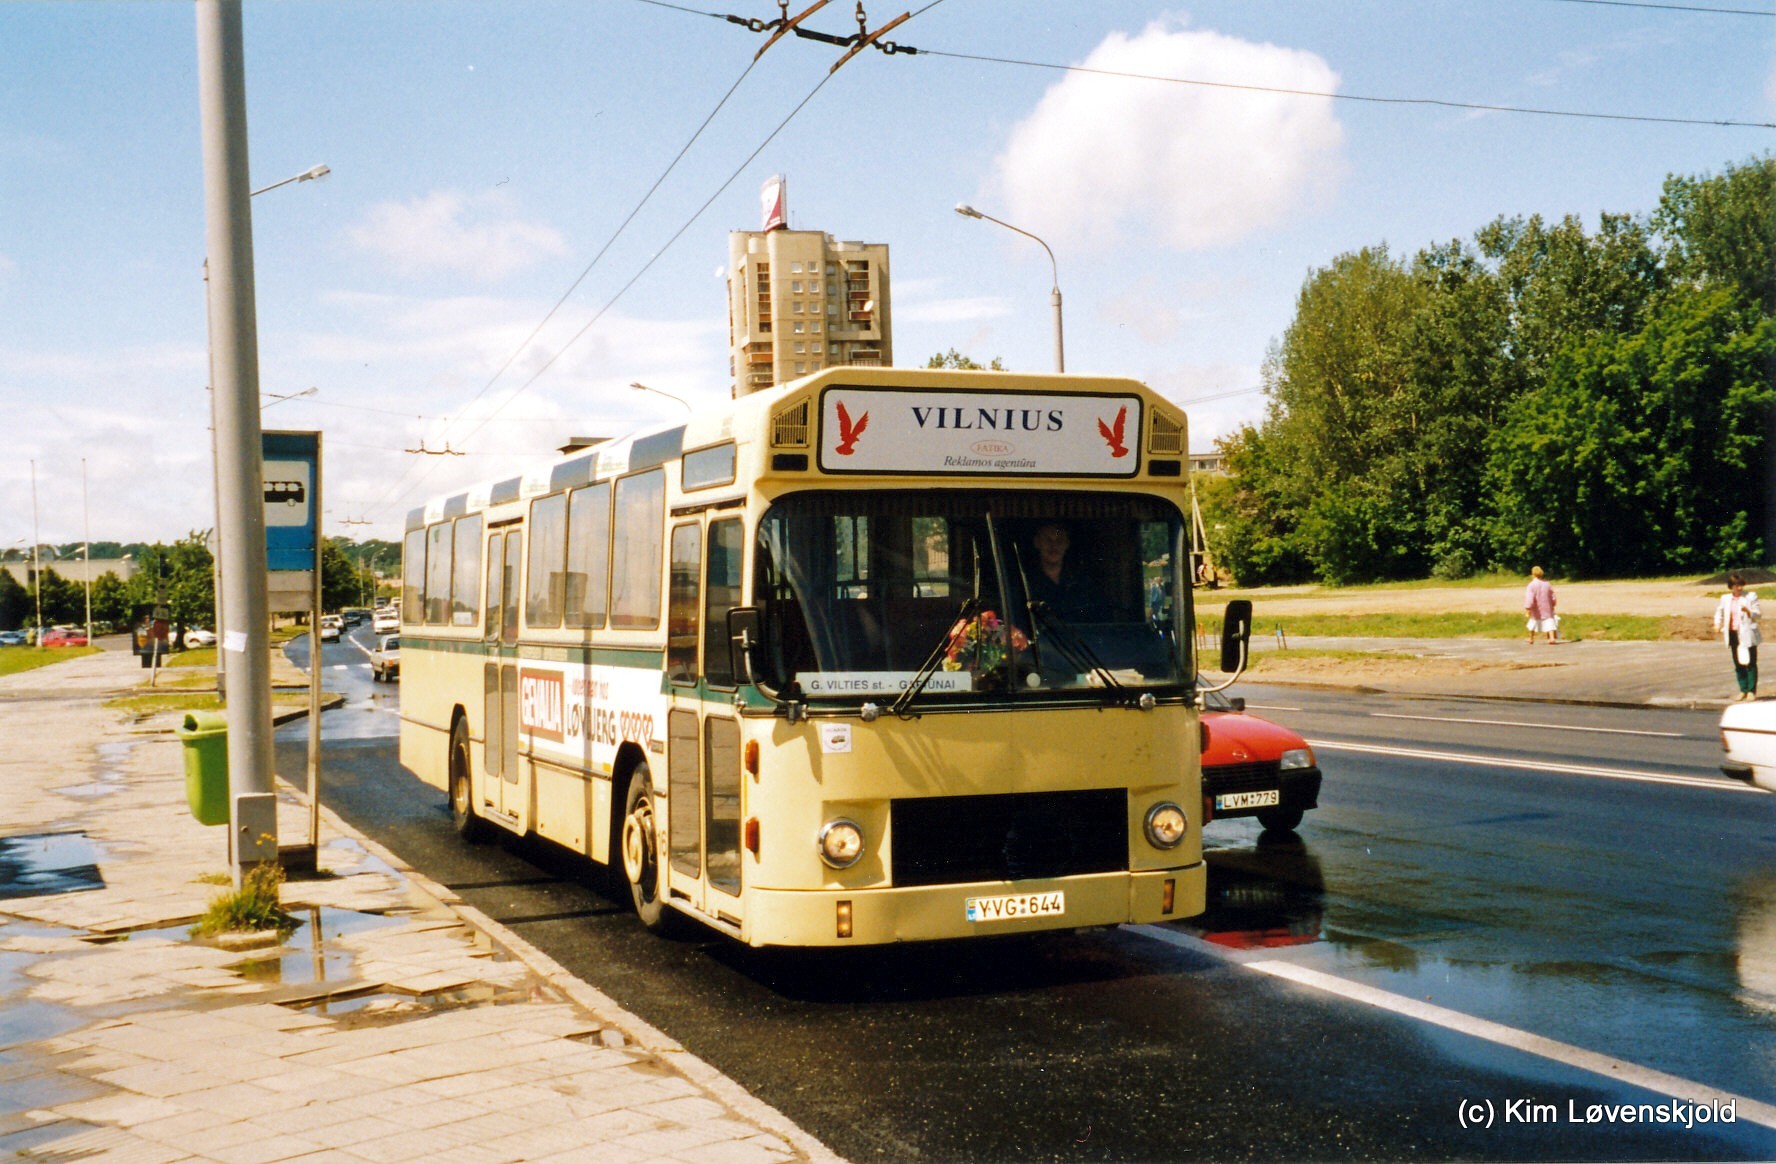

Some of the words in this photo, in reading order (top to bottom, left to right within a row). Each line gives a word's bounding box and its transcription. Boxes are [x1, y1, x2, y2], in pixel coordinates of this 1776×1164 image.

[911, 406, 1063, 431] VILNIUS
[944, 456, 992, 468] Reklamos
[811, 680, 823, 690] G.
[827, 680, 868, 689] VILTIES
[872, 680, 885, 690] st.
[899, 678, 955, 689] GRŪNAI
